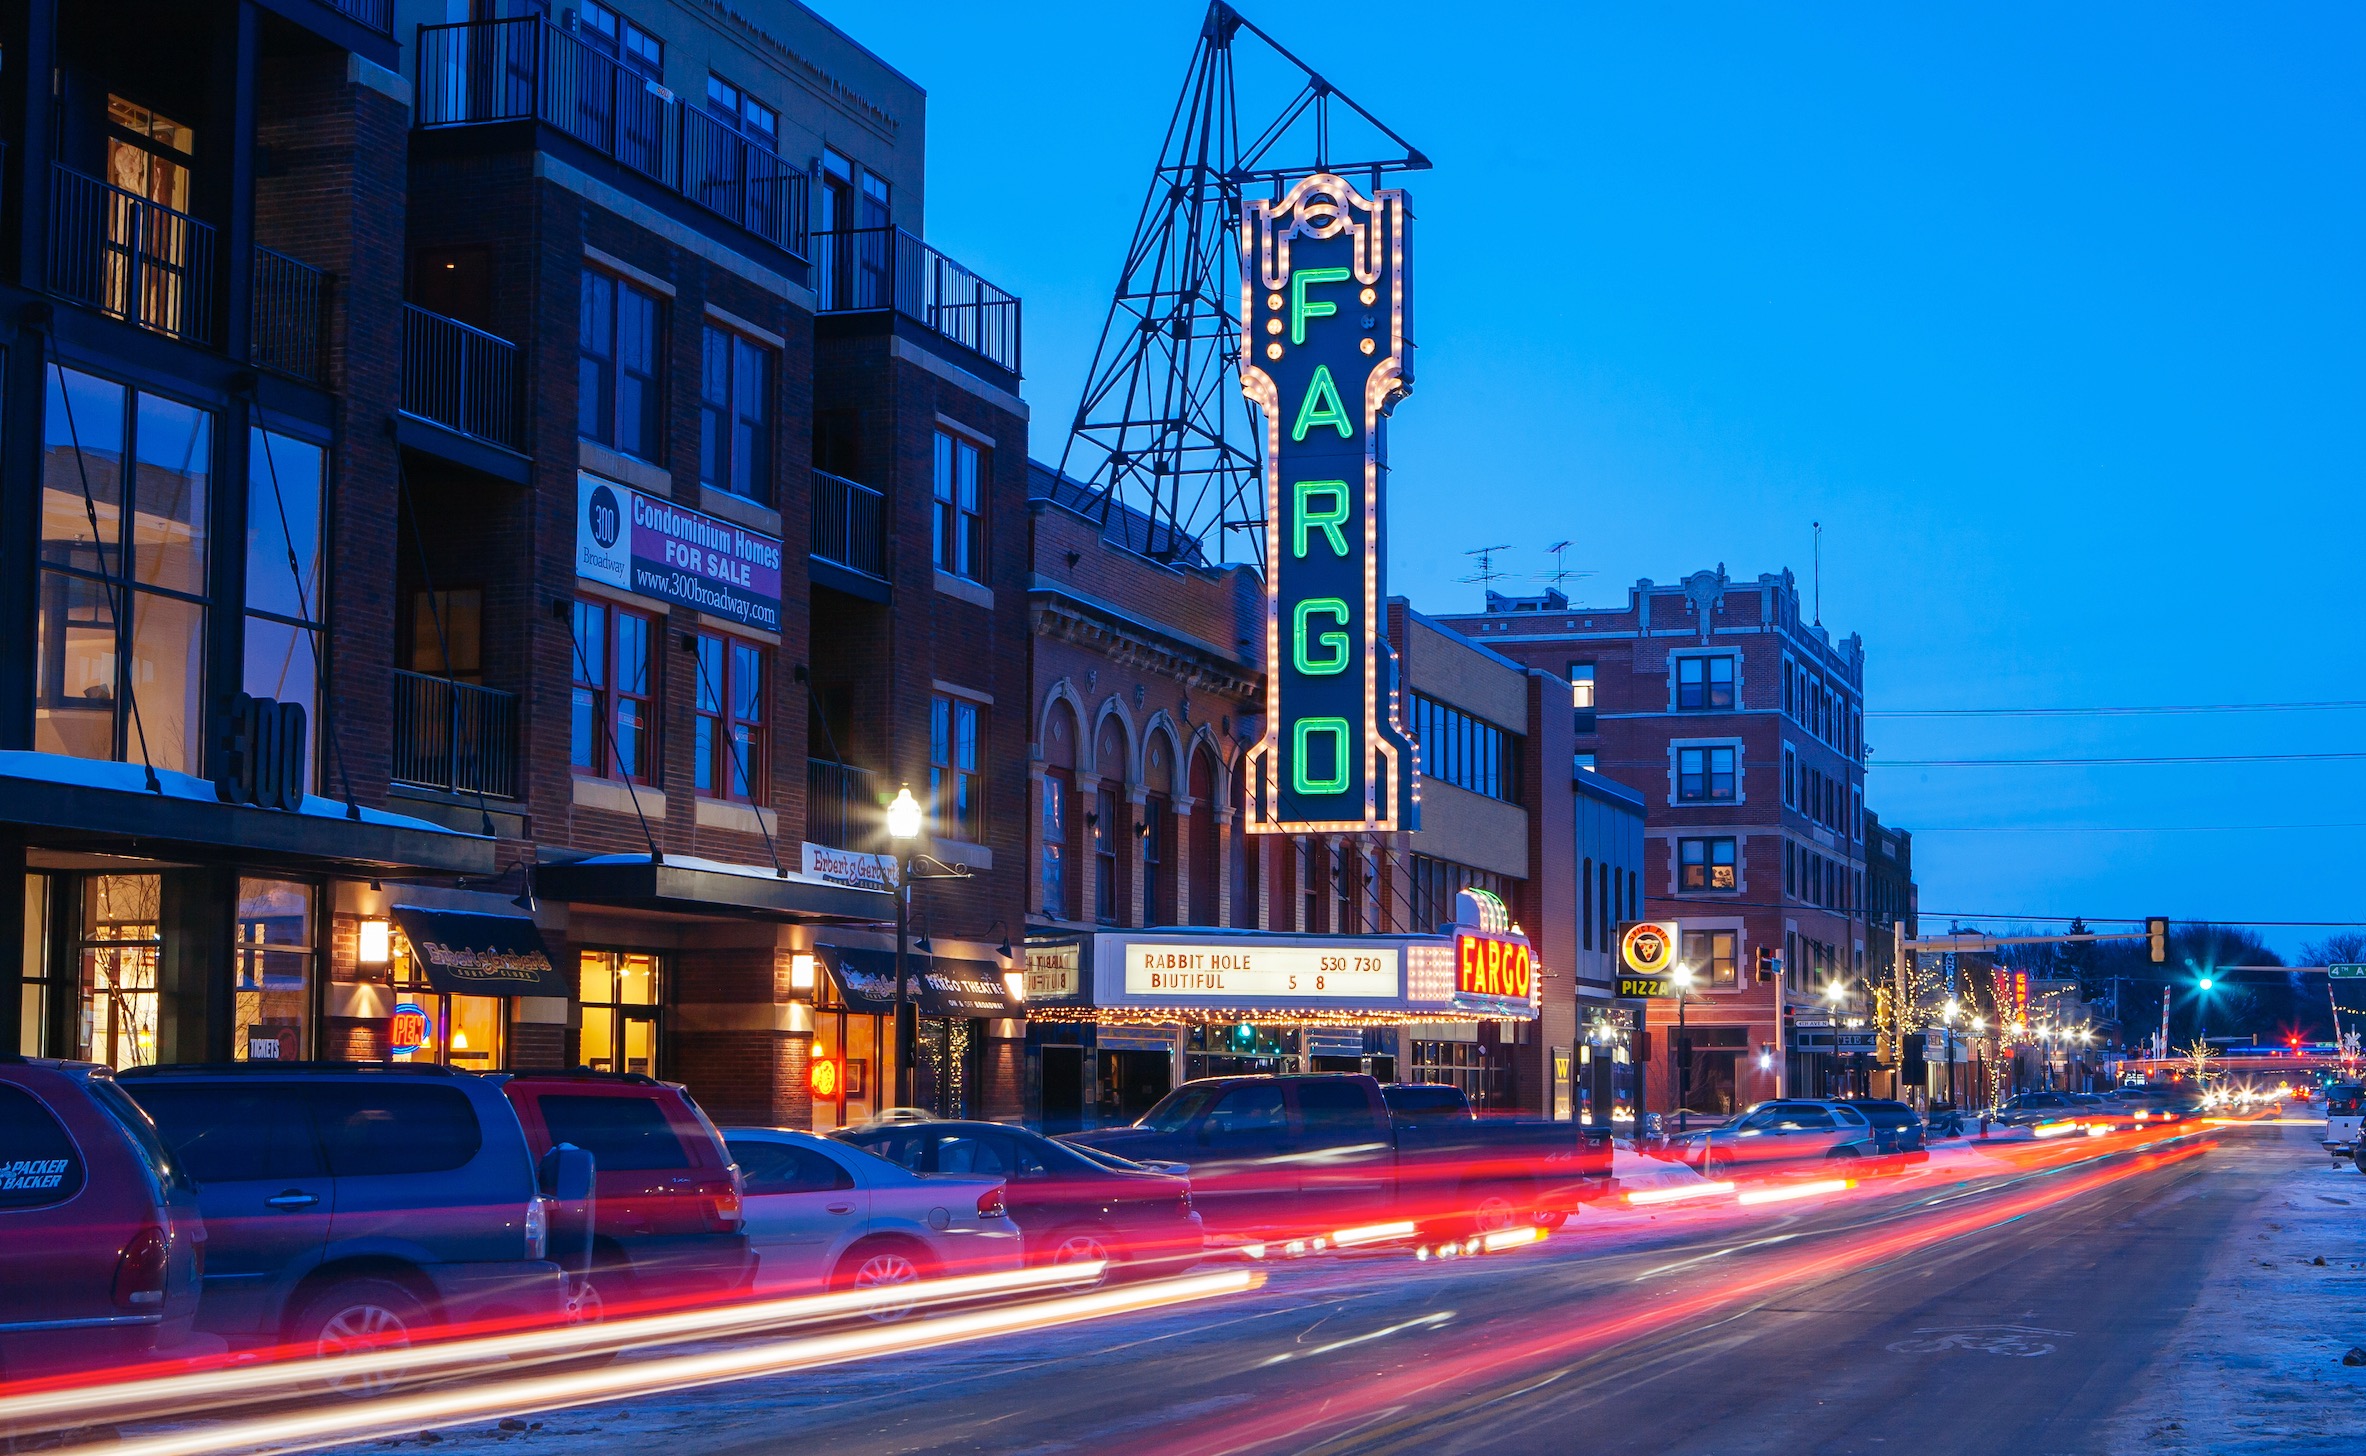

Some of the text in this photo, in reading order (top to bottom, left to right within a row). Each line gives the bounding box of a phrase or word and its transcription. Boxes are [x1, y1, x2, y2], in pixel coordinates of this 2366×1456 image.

[595, 505, 614, 543] 300
[634, 495, 779, 570] Condominium Homes
[1291, 266, 1353, 795] FARGO
[583, 547, 625, 578] Broadway
[665, 539, 751, 587] FOR SALE
[636, 568, 776, 624] www.300broadway.com
[214, 691, 307, 812] 300
[813, 849, 849, 875] Erbert
[1655, 928, 1668, 940] PIE
[1145, 953, 1381, 972] RABBIT HOLE 530 730
[1462, 936, 1529, 997] FARGO
[927, 978, 961, 992] FARGO
[961, 980, 1005, 995] THEATRE
[1152, 973, 1325, 990] BIUTIFUL 5 8
[1622, 980, 1669, 996] PIZZA
[974, 1001, 1004, 1009] BROADWAY
[393, 1014, 425, 1046] PEN
[250, 1038, 280, 1059] TICKETS
[1555, 1058, 1570, 1078] W
[12, 1159, 69, 1176] PACKER
[3, 1174, 63, 1190] BACKER
